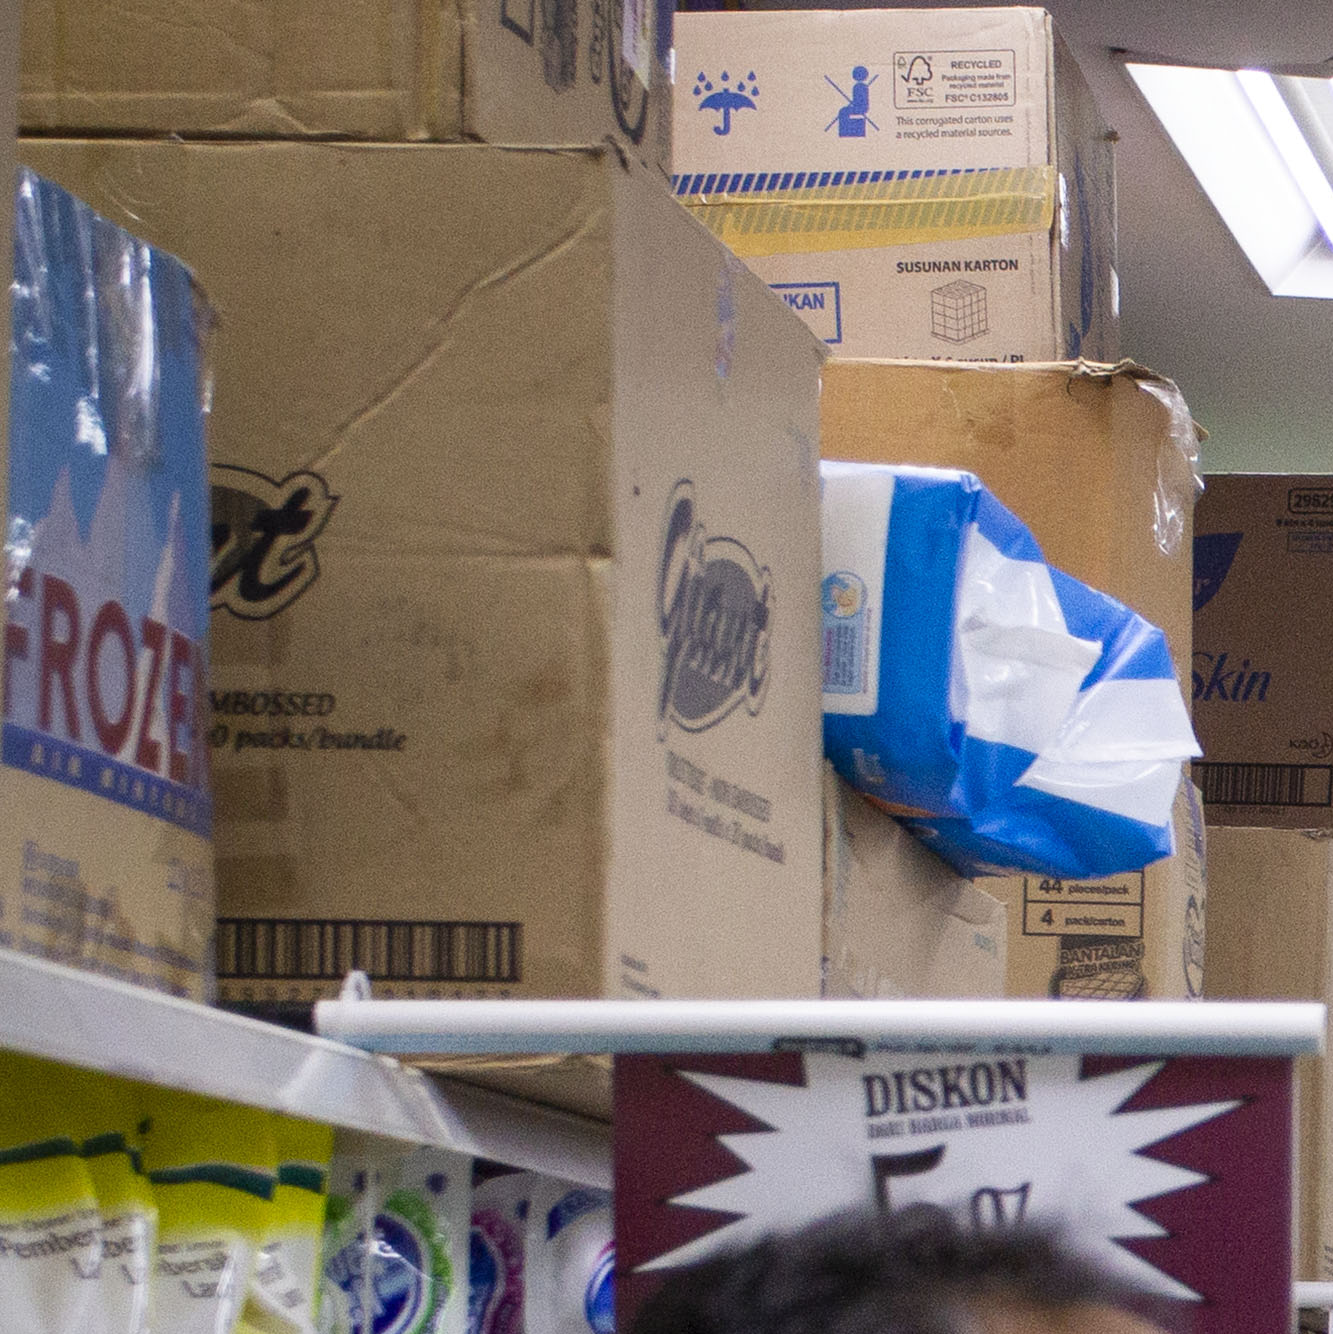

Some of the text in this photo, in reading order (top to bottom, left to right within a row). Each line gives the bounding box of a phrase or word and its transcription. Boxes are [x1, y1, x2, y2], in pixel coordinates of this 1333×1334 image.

[950, 60, 1002, 70] RECYCLED
[906, 88, 934, 97] FSC
[896, 115, 1014, 127] This corrugated carton uses
[903, 129, 940, 140] recycled
[940, 128, 977, 138] material
[896, 259, 1019, 274] SUSUNAN KARTON
[783, 293, 825, 311] KAN
[1041, 908, 1055, 926] 4
[863, 1058, 1028, 1118] DISKON
